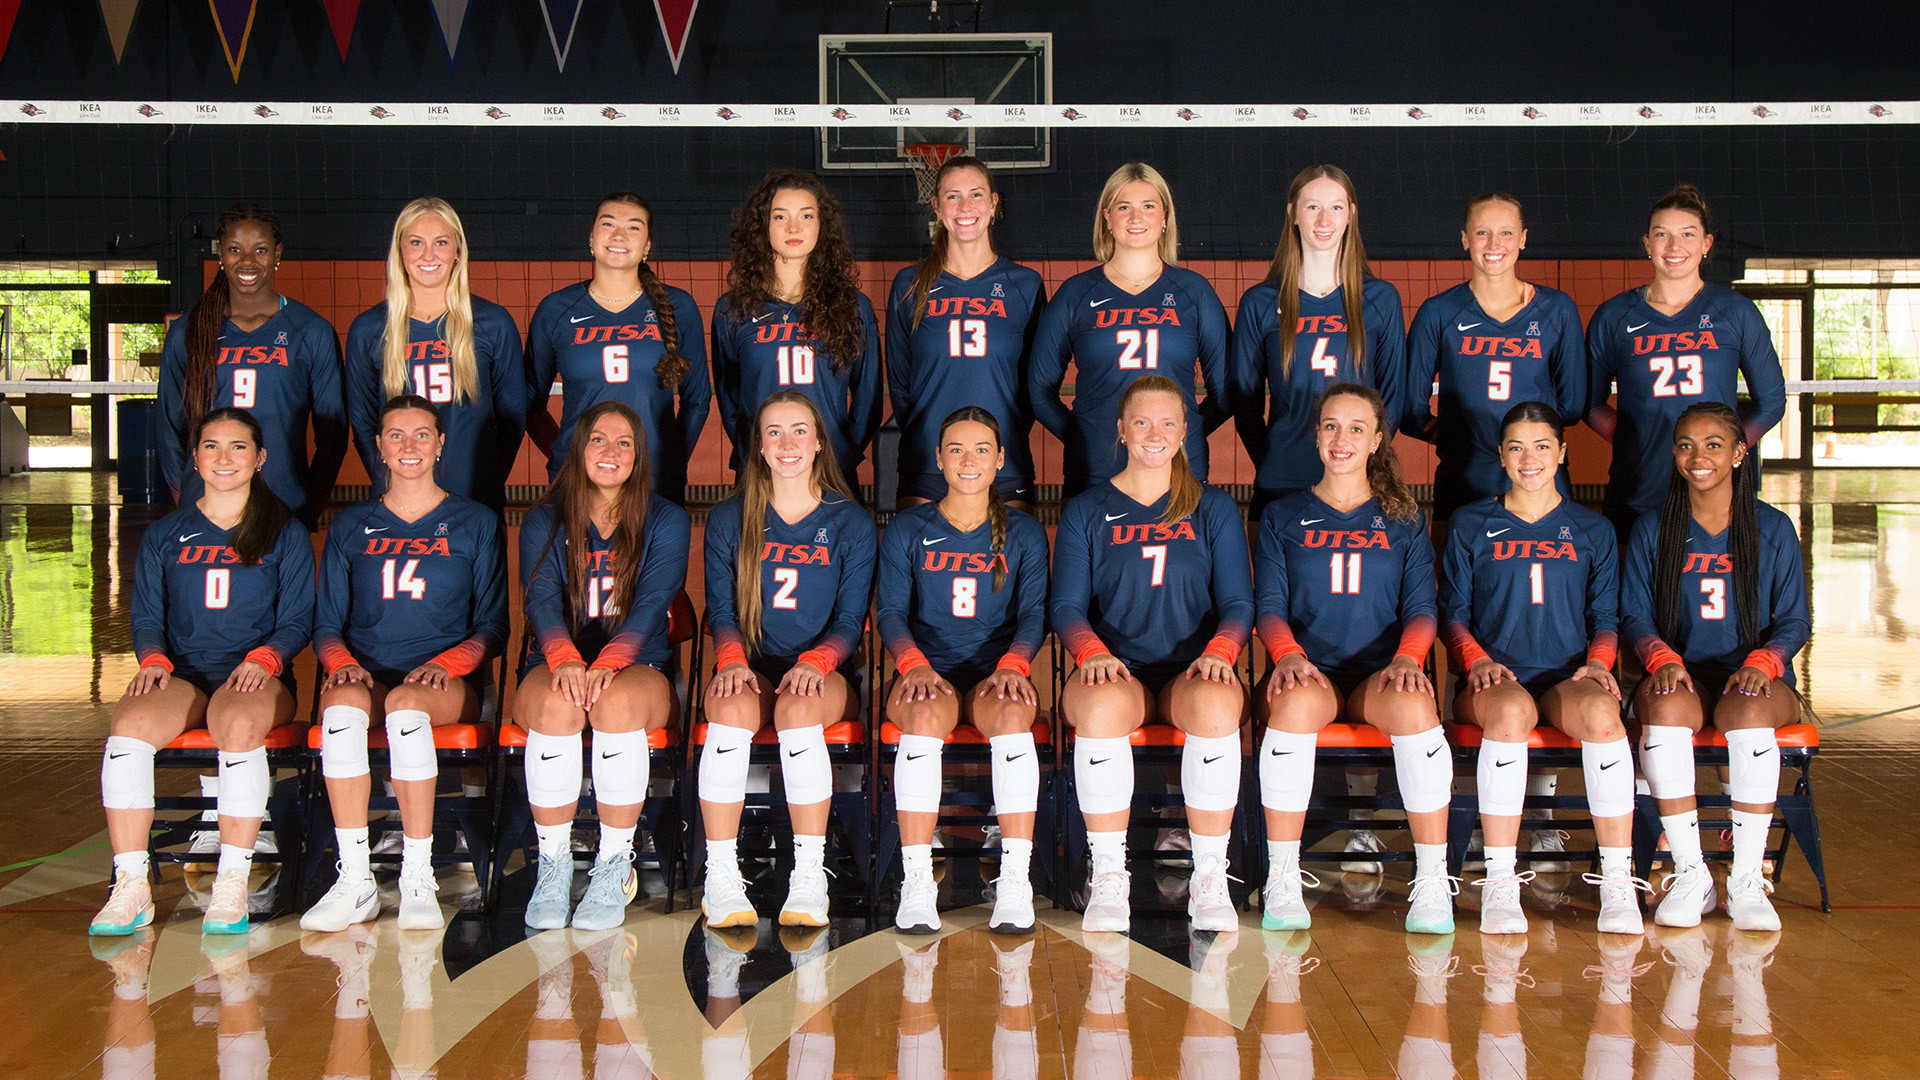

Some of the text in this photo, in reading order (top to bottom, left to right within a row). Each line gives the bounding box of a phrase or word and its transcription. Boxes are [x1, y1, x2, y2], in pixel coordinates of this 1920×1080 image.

[80, 104, 100, 112] IKEA
[196, 105, 216, 113] IKEA
[312, 106, 332, 114] IKEA
[428, 106, 448, 114] IKEA
[544, 107, 564, 115] IKEA
[659, 107, 679, 115] IKEA
[775, 108, 795, 116] IKEA
[890, 108, 910, 116] IKEA
[1005, 108, 1025, 116] IKEA
[1120, 108, 1140, 116] IKEA
[1235, 108, 1255, 116] IKEA
[1350, 107, 1370, 115] IKEA
[1465, 107, 1485, 115] IKEA
[1580, 107, 1600, 115] IKEA
[1695, 106, 1716, 114] IKEA
[1810, 105, 1831, 113] IKEA
[927, 297, 1007, 318] UTSA
[1094, 307, 1181, 329] UTSA
[572, 324, 662, 346] UTSA
[947, 319, 987, 357] 13
[1632, 331, 1719, 356] UTSA
[1115, 328, 1159, 369] 21
[1310, 337, 1338, 377] 4
[1458, 336, 1543, 358] UTSA
[602, 344, 629, 383] 6
[777, 346, 815, 385] 10
[413, 363, 454, 403] 15
[1488, 361, 1512, 401] 5
[1650, 355, 1704, 397] 23
[233, 368, 257, 408] 9
[1110, 521, 1197, 546] UTSA
[1300, 530, 1391, 549] UTSA
[177, 545, 263, 565] UTS
[363, 537, 451, 556] UTSA
[1491, 540, 1578, 561] UTSA
[921, 551, 1009, 573] UTSA
[1141, 545, 1168, 587] 7
[1329, 552, 1362, 594] 11
[204, 568, 231, 609] 0
[381, 559, 426, 600] 14
[773, 567, 799, 610] 2
[1529, 563, 1544, 604] 1
[588, 576, 621, 618] 12
[952, 577, 977, 618] 8
[1700, 578, 1726, 620] 3
